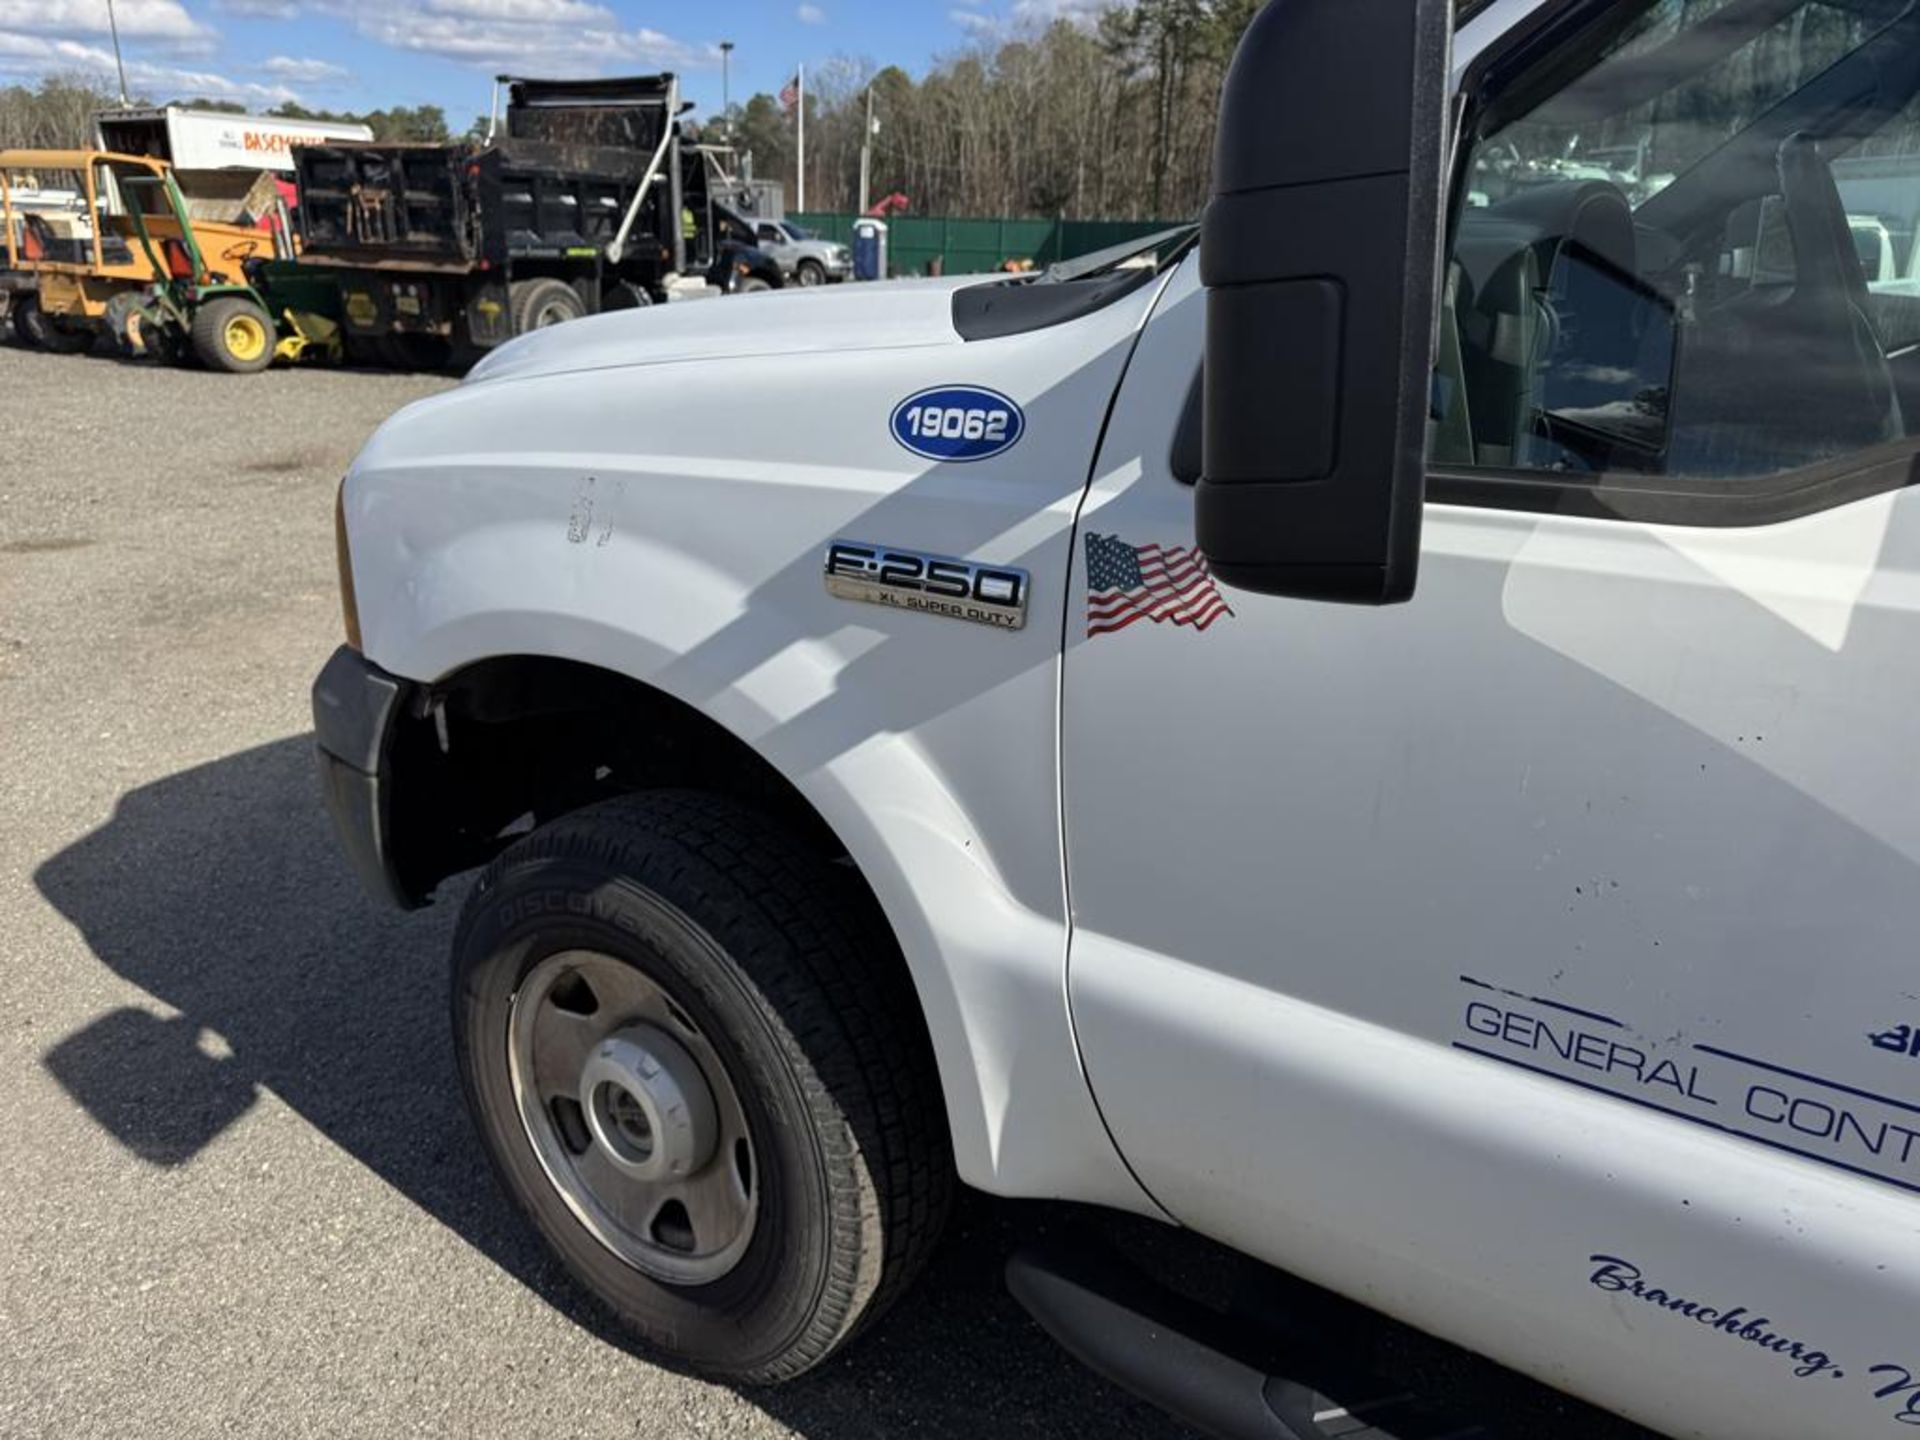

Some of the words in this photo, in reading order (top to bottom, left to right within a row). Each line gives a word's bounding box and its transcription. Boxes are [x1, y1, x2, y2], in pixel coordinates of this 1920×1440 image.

[906, 406, 1008, 441] 19062
[879, 591, 901, 604] XL
[906, 597, 963, 617] SUPER
[967, 608, 1017, 625] DUTY
[1465, 1001, 1718, 1105] GENERAL
